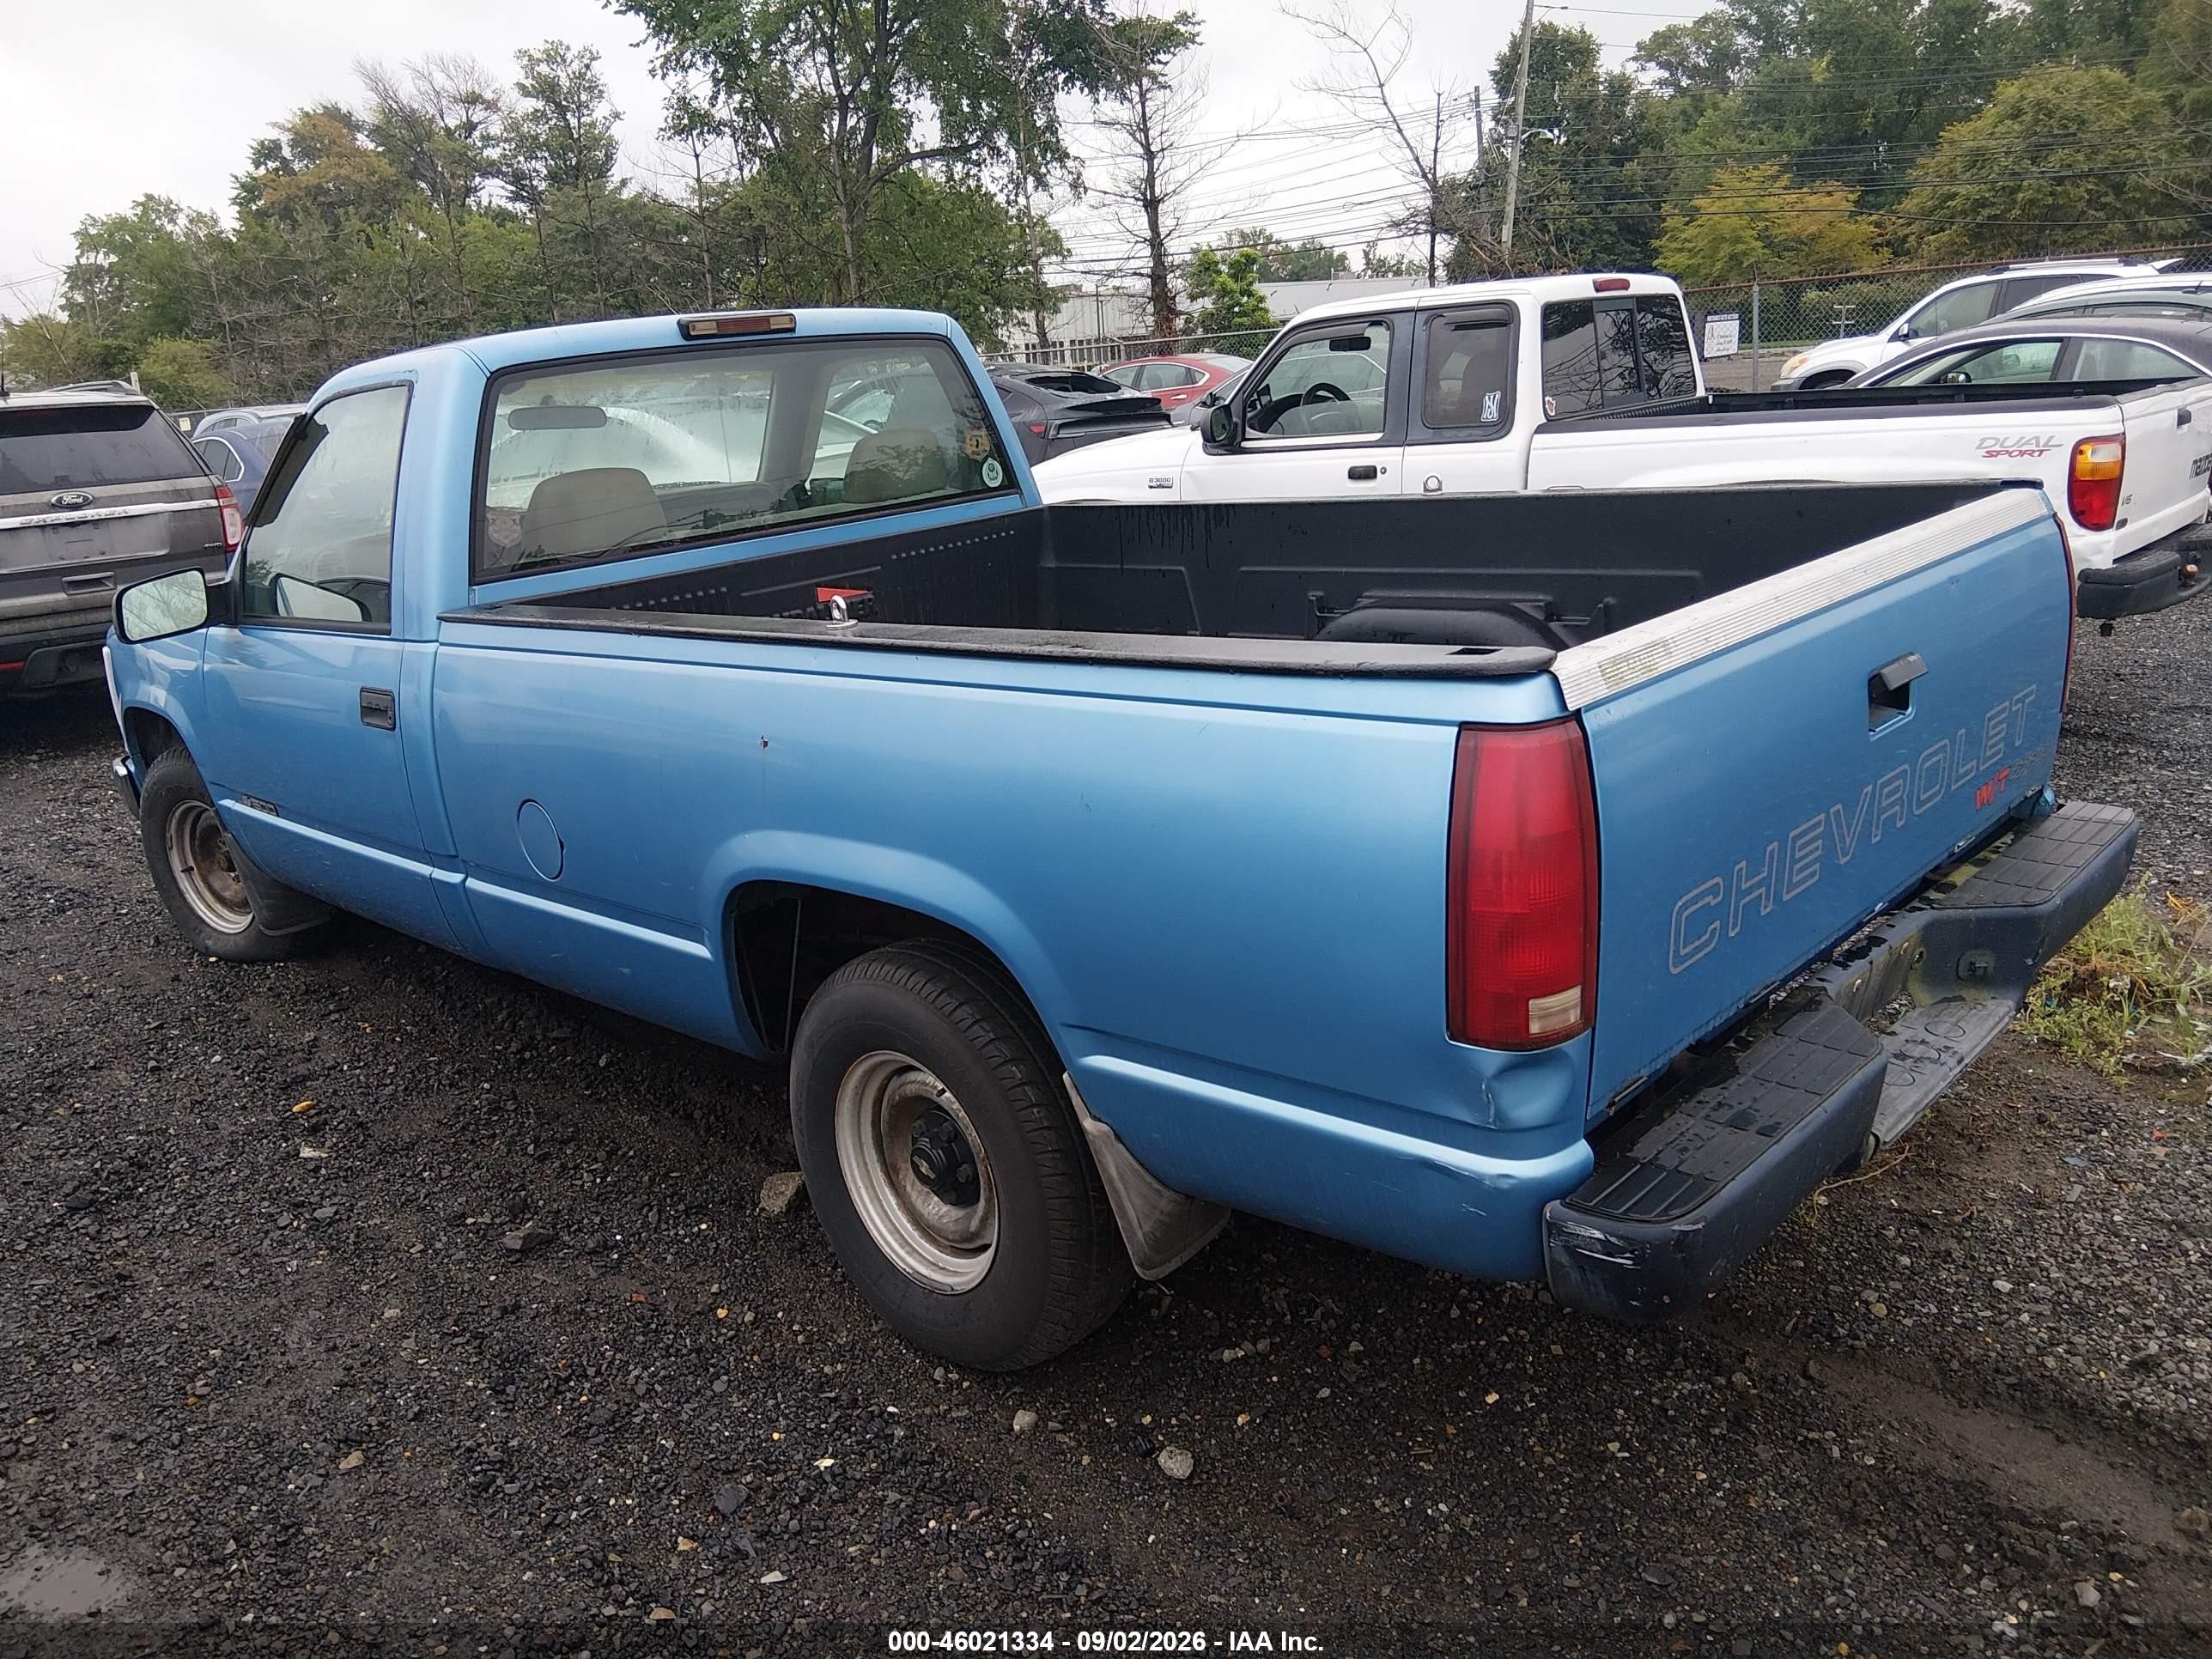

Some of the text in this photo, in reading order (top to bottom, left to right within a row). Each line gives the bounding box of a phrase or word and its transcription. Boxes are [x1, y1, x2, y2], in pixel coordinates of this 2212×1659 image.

[1976, 435, 2063, 449] DUAL
[1982, 448, 2051, 458] SPORT
[61, 494, 83, 505] Ford
[1668, 684, 2036, 975] CHEVROLET
